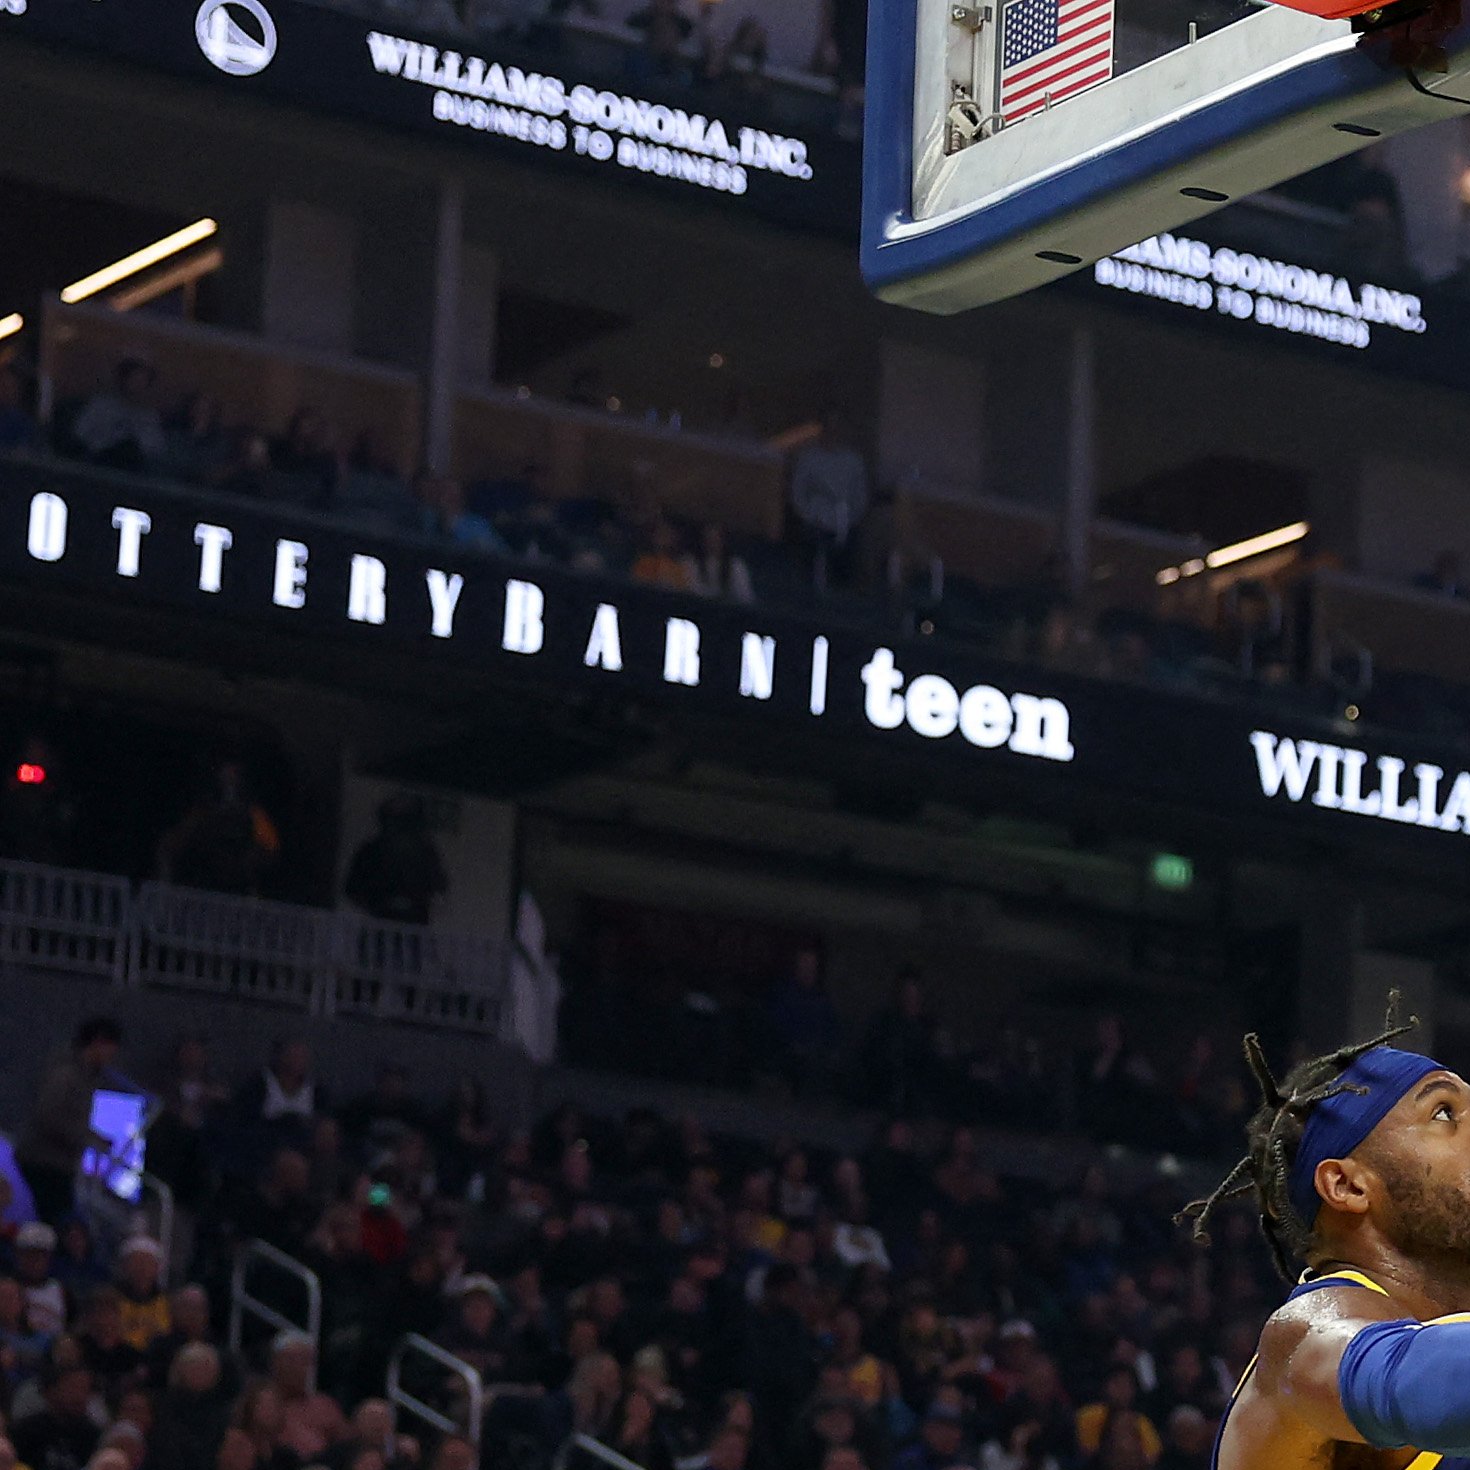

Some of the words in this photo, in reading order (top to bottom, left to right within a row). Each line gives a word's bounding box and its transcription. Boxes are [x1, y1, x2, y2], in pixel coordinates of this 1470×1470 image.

[433, 90, 567, 150] BUSINESS
[572, 125, 614, 161] TO
[617, 137, 748, 195] BUSINESS
[1217, 285, 1253, 319] TO
[861, 647, 1075, 762] teen
